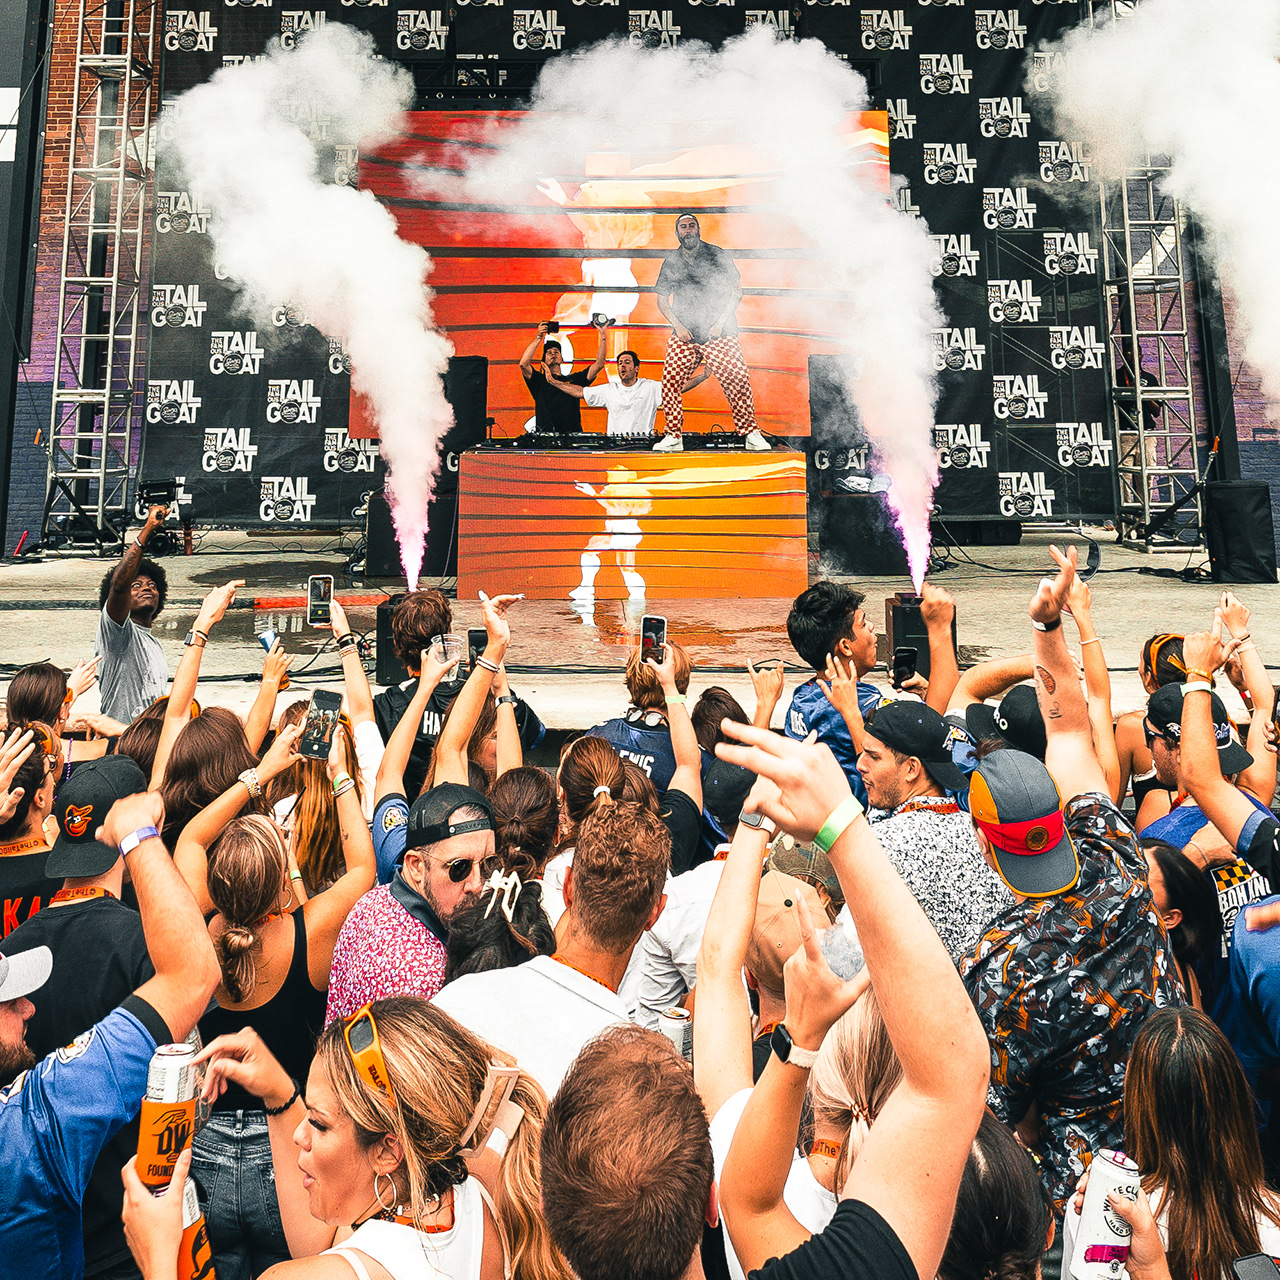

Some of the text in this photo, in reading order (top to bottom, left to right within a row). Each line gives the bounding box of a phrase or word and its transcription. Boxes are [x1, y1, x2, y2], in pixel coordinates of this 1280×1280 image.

[166, 11, 217, 31] TAIL
[398, 10, 449, 30] TAIL
[514, 10, 565, 30] TAIL
[862, 10, 912, 30] TAIL
[976, 10, 1027, 30] TAIL
[921, 54, 972, 74] TAIL
[980, 97, 1030, 118] TAIL
[925, 143, 977, 164] TAIL
[984, 187, 1036, 208] TAIL
[1044, 233, 1098, 254] TAIL
[153, 285, 207, 306] TAIL
[988, 280, 1041, 301] TAIL
[211, 332, 264, 353] TAIL
[1050, 326, 1105, 348] TAIL
[148, 380, 201, 402] TAIL
[268, 380, 321, 402] TAIL
[994, 375, 1048, 397] TAIL
[203, 428, 258, 450] TAIL
[936, 424, 990, 446] TAIL
[1057, 423, 1112, 445] TAIL
[261, 477, 316, 500] TAIL
[1000, 472, 1055, 495] TAIL
